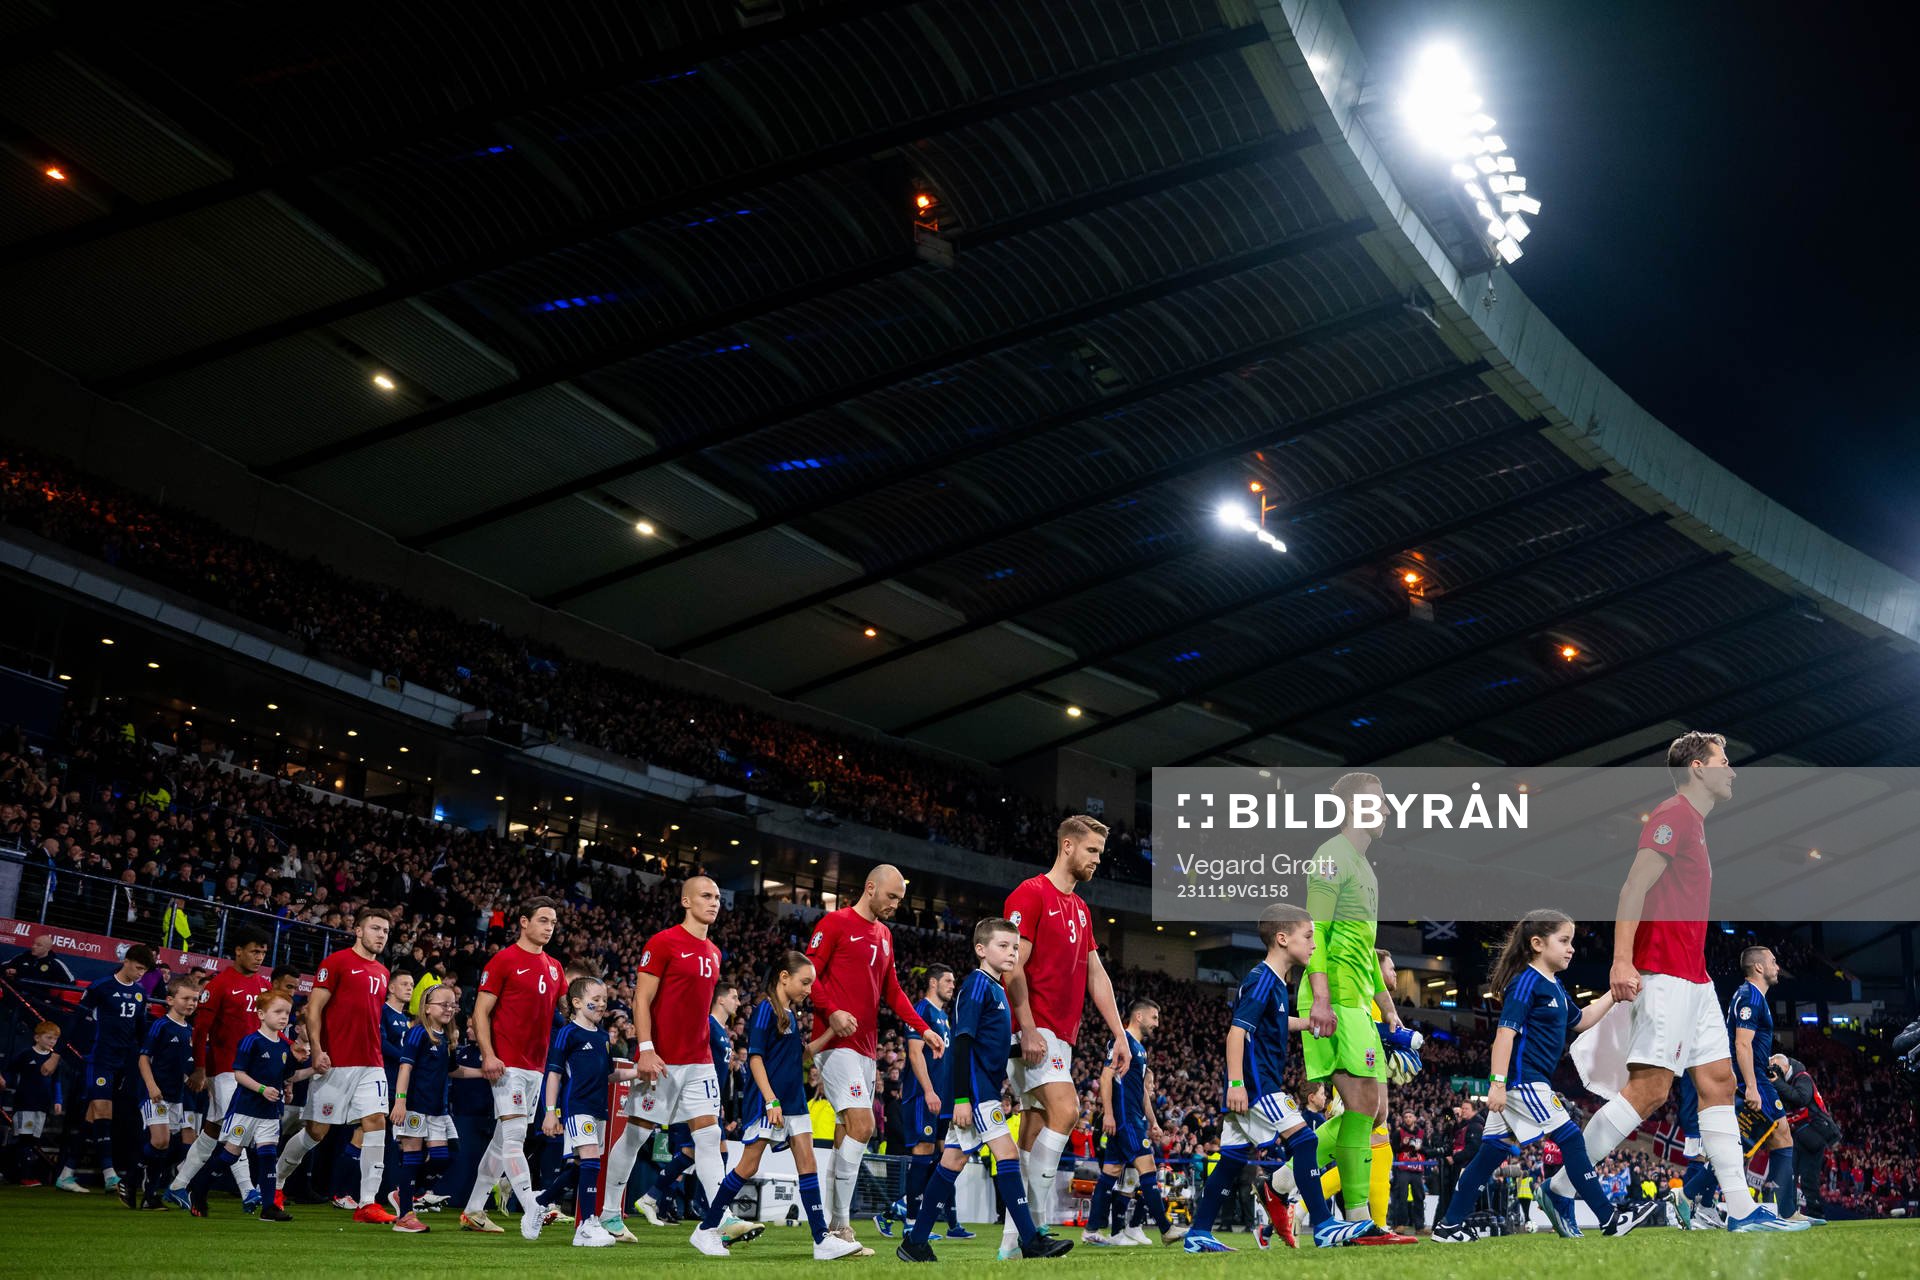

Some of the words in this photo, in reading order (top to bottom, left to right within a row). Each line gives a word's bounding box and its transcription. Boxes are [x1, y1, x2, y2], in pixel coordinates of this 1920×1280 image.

[1068, 919, 1077, 944] 3
[870, 944, 878, 967] 7
[698, 955, 712, 979] 15
[369, 975, 381, 995] 17
[538, 974, 547, 995] 6
[120, 1001, 136, 1018] 13
[375, 1080, 387, 1097] 17
[703, 1079, 719, 1099] 15
